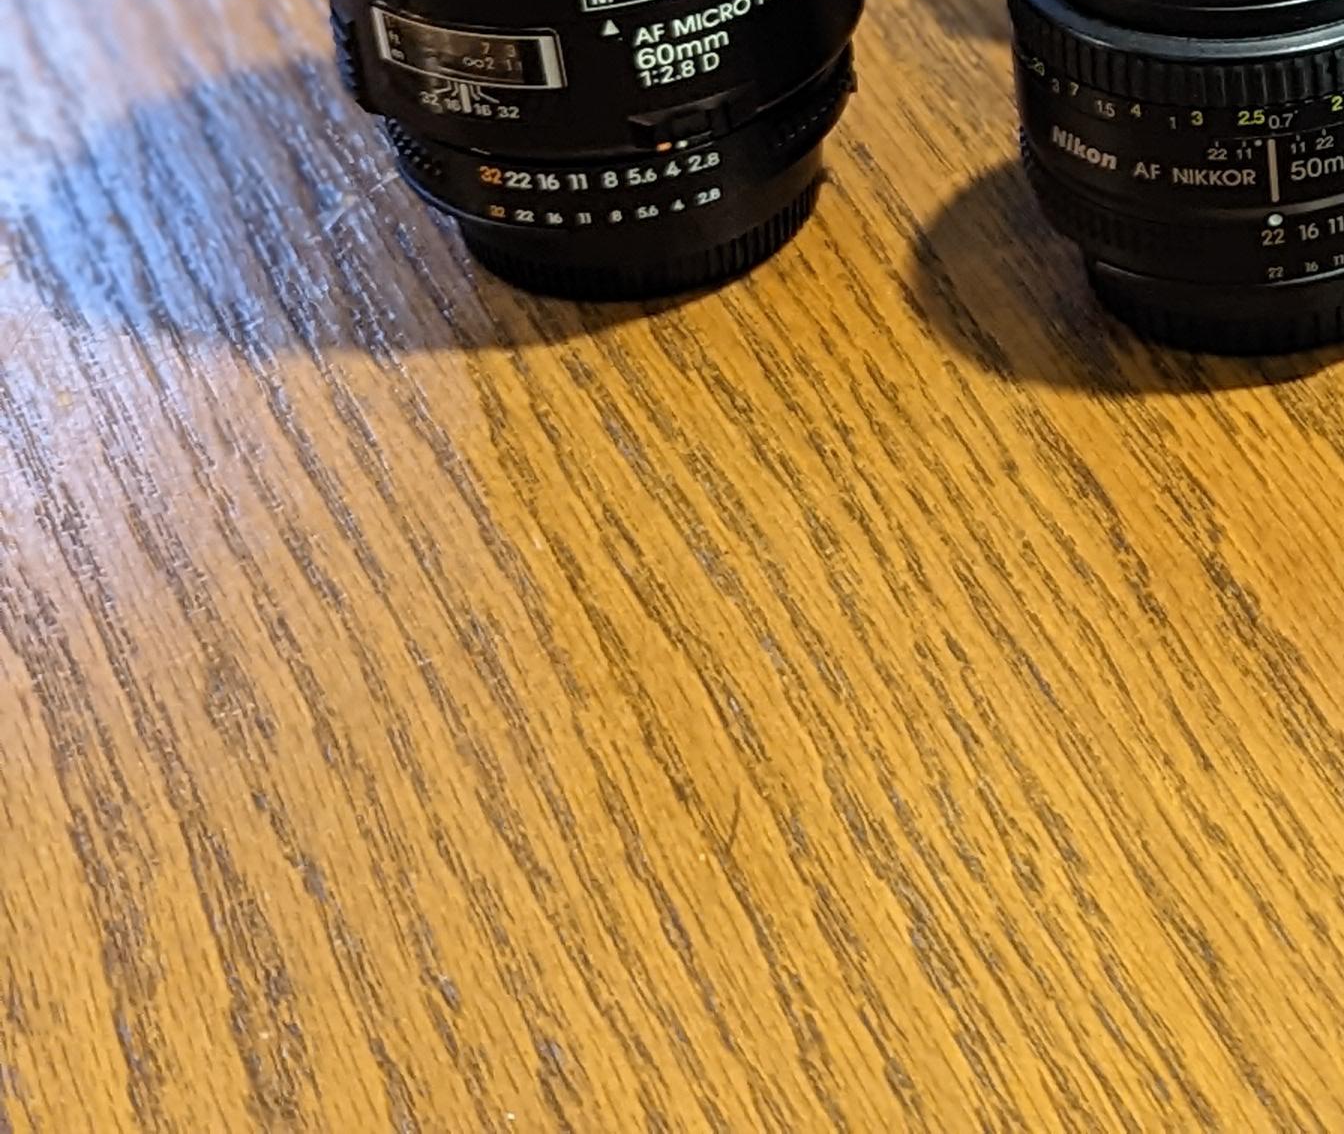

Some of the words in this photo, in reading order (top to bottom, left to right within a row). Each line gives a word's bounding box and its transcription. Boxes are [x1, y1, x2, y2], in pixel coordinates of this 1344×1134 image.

[635, 23, 666, 47] AF
[635, 30, 730, 69] 60mm
[640, 60, 695, 87] 1:2.8
[703, 52, 720, 72] D
[498, 106, 520, 119] 32
[1130, 103, 1141, 118] 4
[1191, 111, 1203, 126] 3
[1237, 109, 1265, 126] 2.5
[1331, 95, 1343, 111] 2
[1268, 112, 1294, 129] 0.7
[1052, 125, 1118, 171] Nikon
[1133, 162, 1161, 180] AF
[1172, 167, 1256, 187] NIKKOR
[1208, 148, 1228, 160] 22
[1236, 148, 1252, 160] 11
[1291, 141, 1306, 154] 11
[1316, 135, 1335, 151] 22
[479, 165, 503, 185] 32
[504, 171, 533, 189] 22
[536, 174, 560, 190] 16
[567, 174, 588, 190] 11
[603, 171, 618, 188] 8
[628, 167, 657, 185] 5.6
[665, 161, 681, 178] 4
[688, 152, 721, 173] 2.8
[578, 212, 592, 224] 11
[610, 210, 622, 222] 8
[637, 205, 659, 219] 5.6
[671, 199, 685, 211] 4
[697, 188, 721, 205] 2.8
[1261, 229, 1286, 246] 22
[1298, 222, 1319, 241] 16
[1328, 215, 1344, 234] 11
